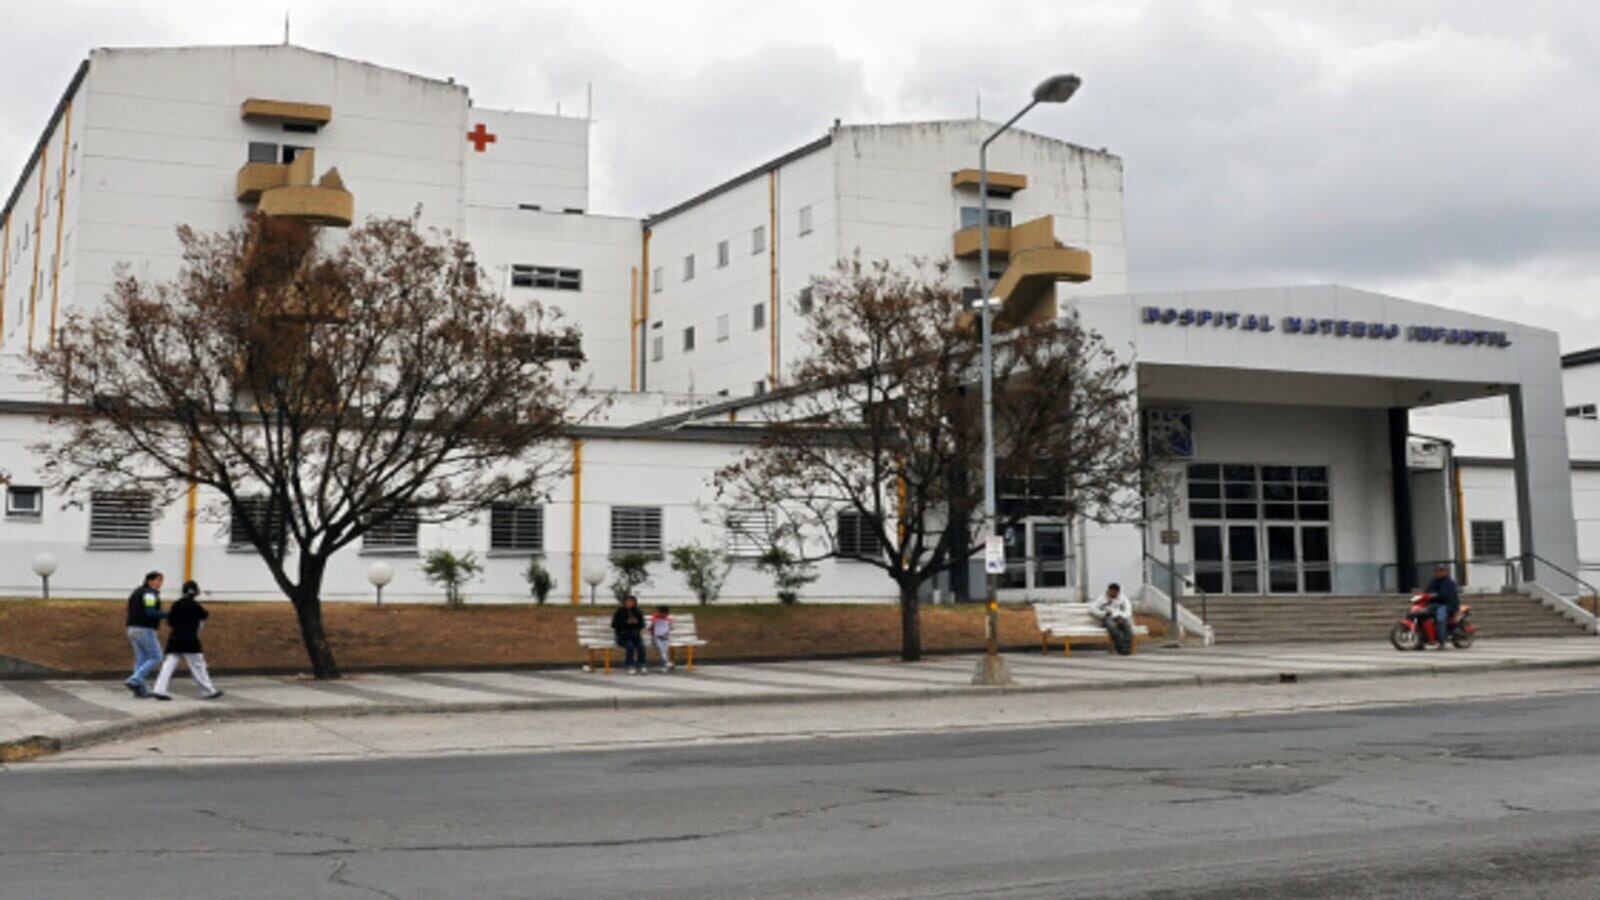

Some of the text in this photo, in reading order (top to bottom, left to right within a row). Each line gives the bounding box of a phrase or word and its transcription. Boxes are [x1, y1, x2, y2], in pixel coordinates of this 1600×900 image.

[1142, 306, 1512, 348] HOSPITAL MATERNO INFANTIL
